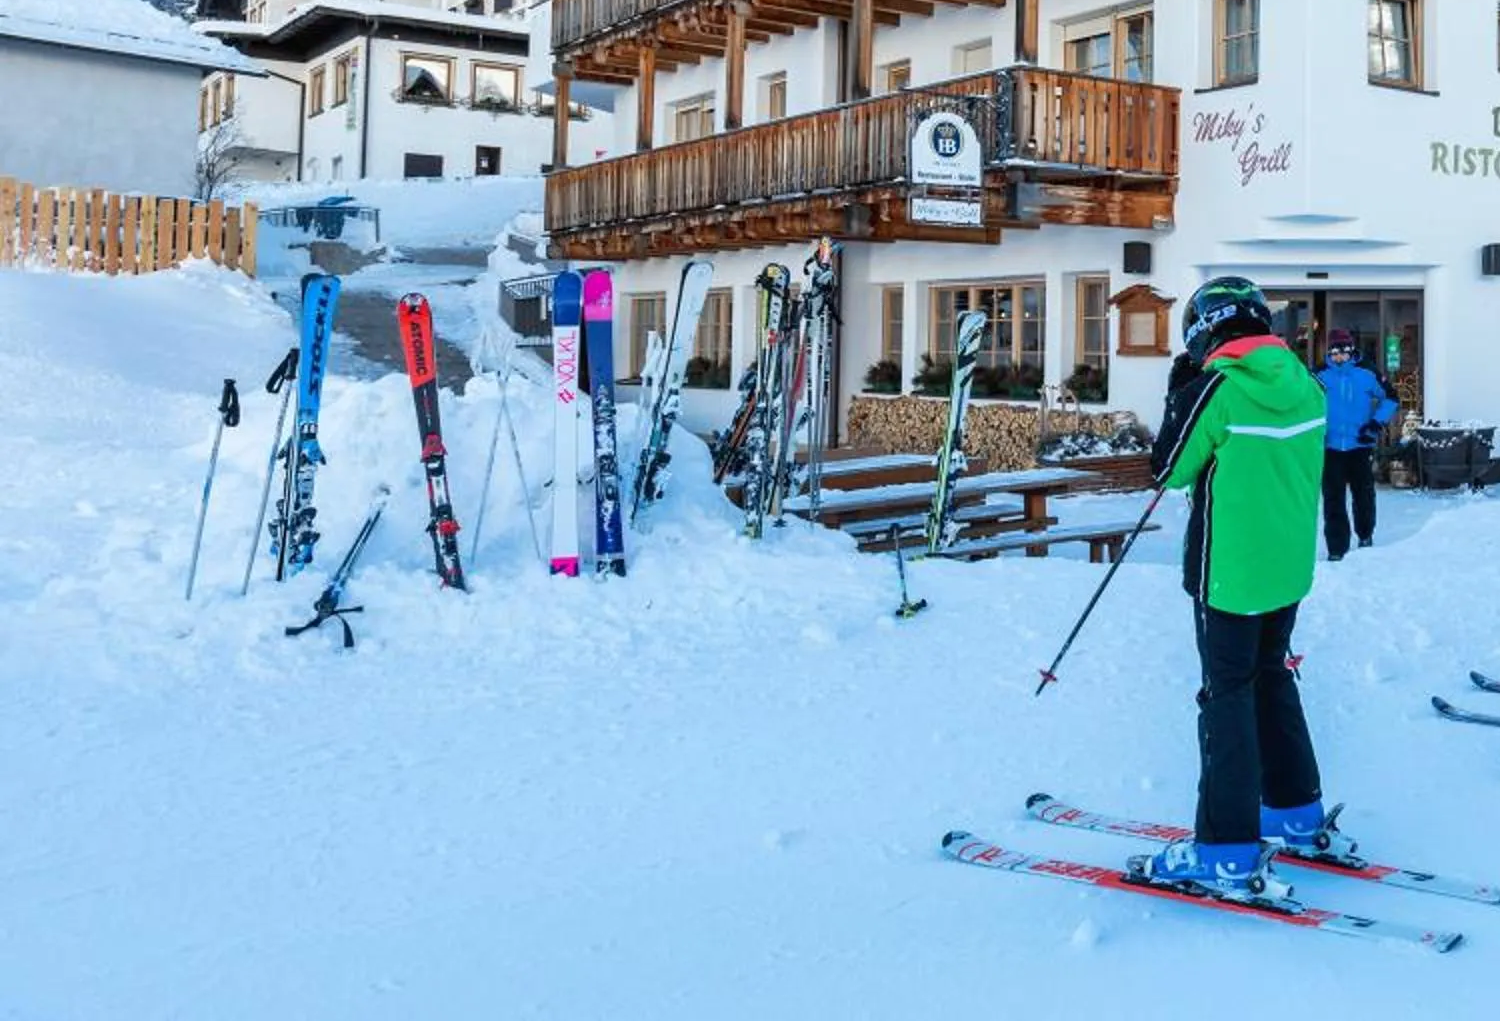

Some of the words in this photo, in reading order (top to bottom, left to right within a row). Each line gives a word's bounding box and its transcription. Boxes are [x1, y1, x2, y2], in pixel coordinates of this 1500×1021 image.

[1193, 103, 1265, 152] Miky's
[1238, 141, 1292, 187] Grill
[410, 321, 429, 376] ATOMIC
